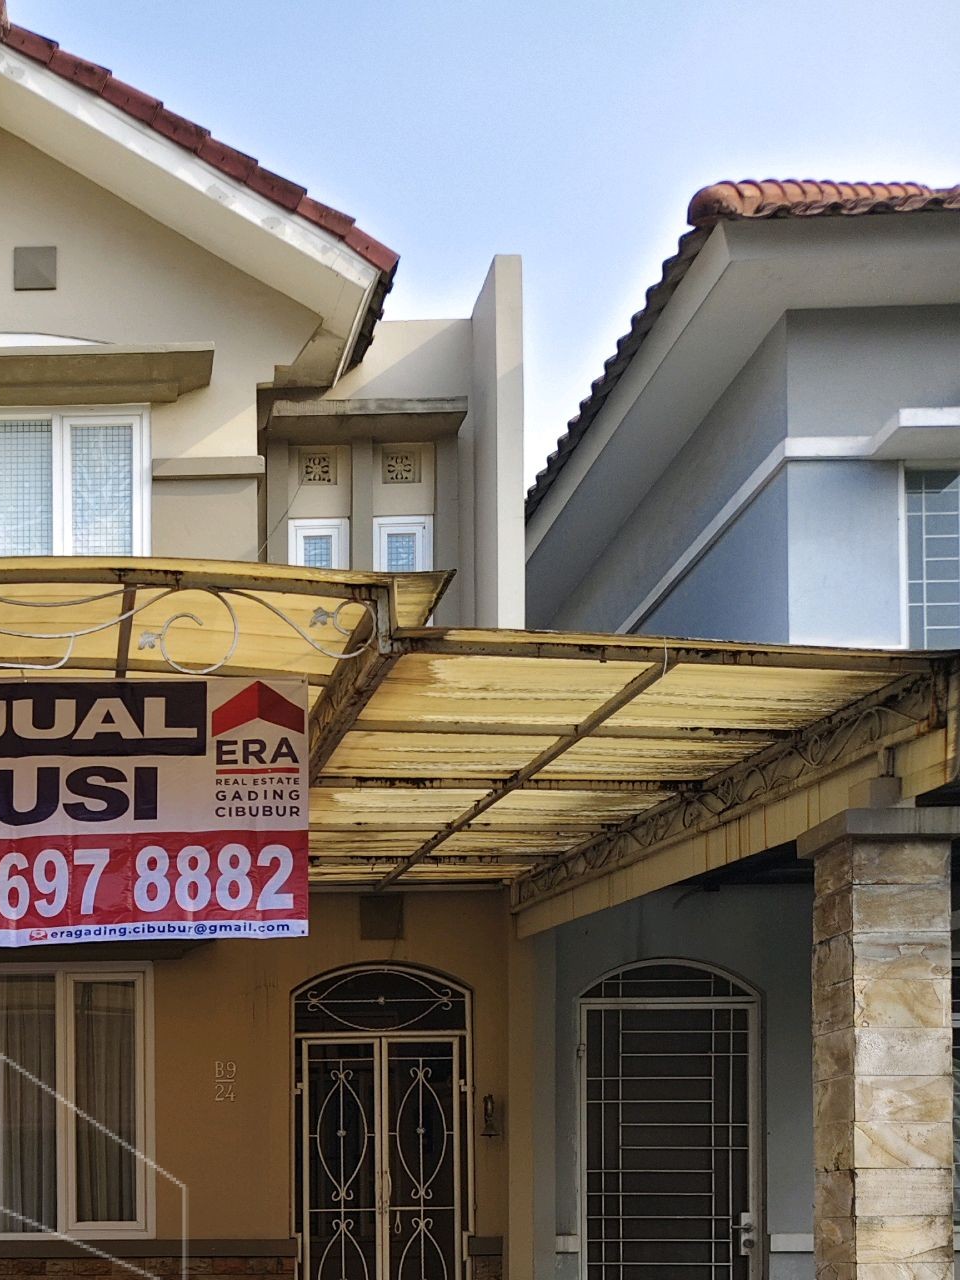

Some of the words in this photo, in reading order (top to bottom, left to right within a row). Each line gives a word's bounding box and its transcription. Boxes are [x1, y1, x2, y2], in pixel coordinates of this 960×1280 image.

[216, 737, 299, 765] ERA
[215, 778, 248, 786] REAL
[253, 777, 300, 786] ESTATE
[215, 789, 300, 802] GADING
[215, 805, 300, 818] CIBUBUR
[133, 843, 295, 916] 8882
[50, 922, 291, 940] eragading.cibubur@gmail.com
[215, 1060, 237, 1079] B9
[215, 1084, 237, 1102] 24
